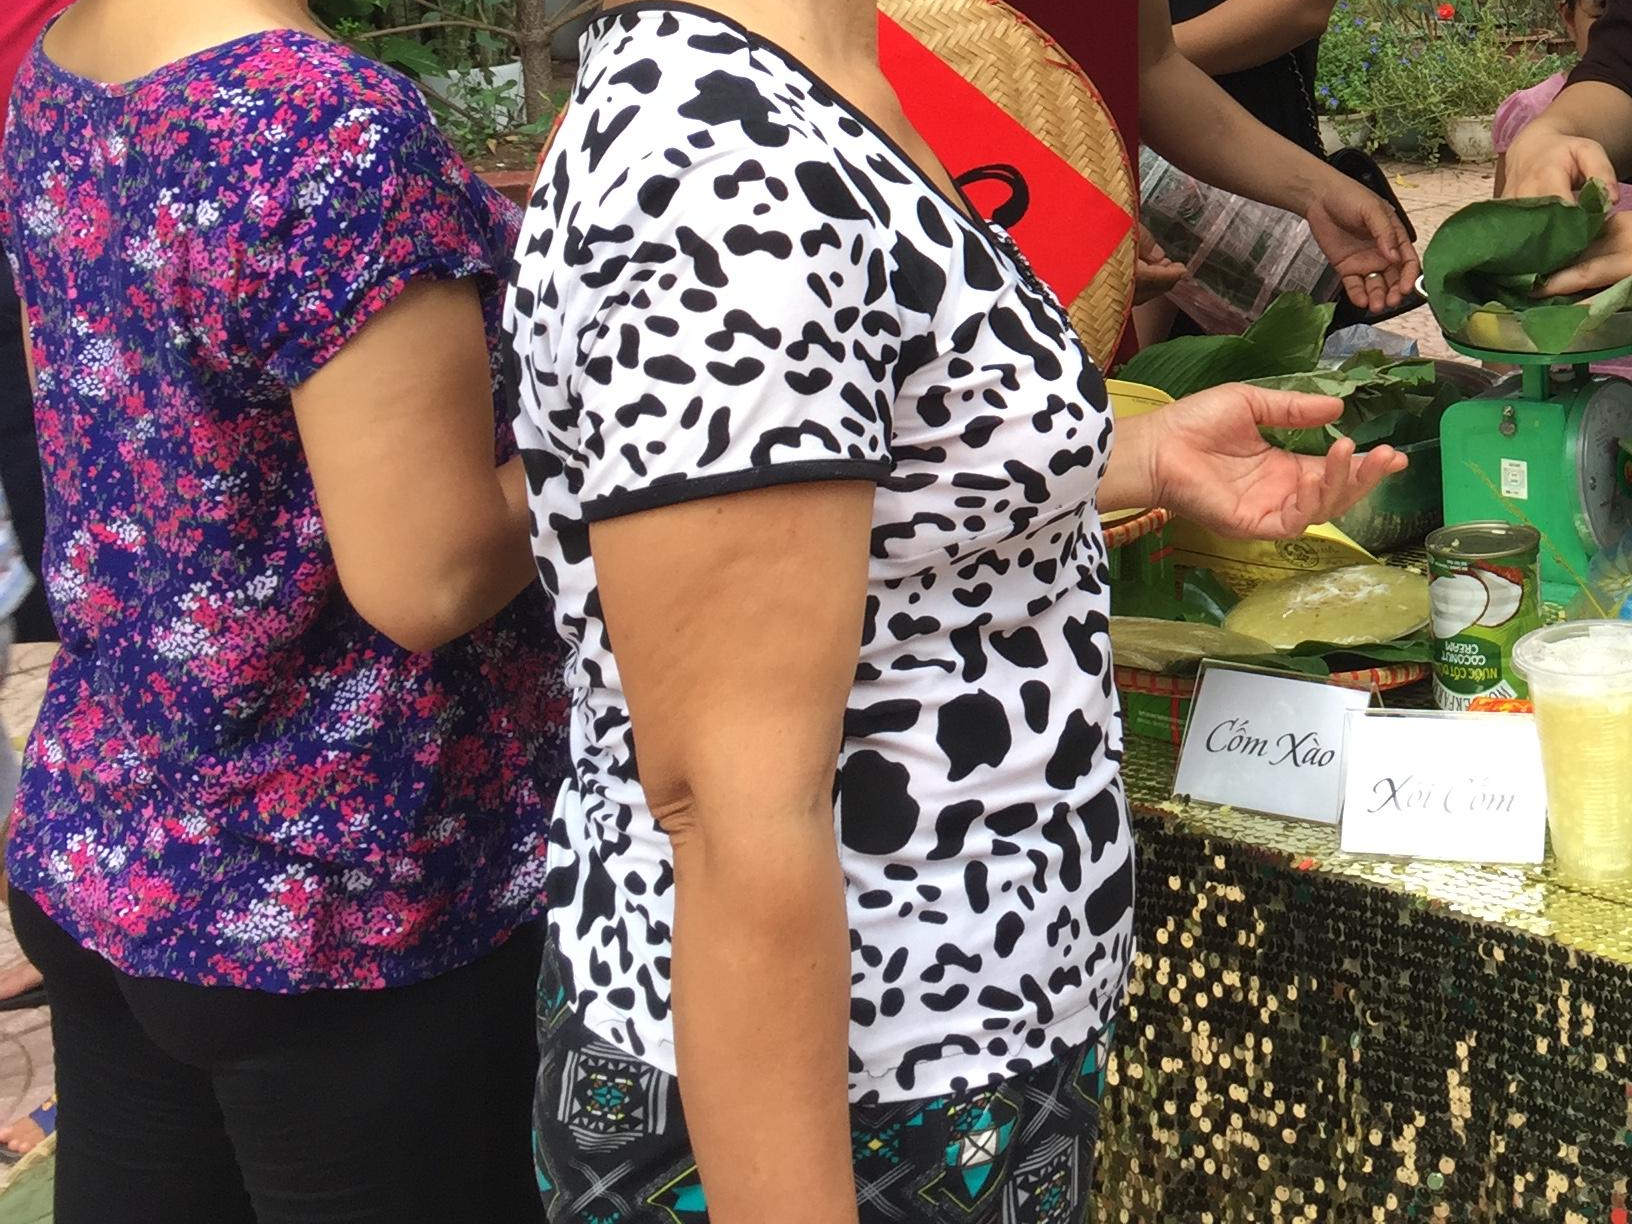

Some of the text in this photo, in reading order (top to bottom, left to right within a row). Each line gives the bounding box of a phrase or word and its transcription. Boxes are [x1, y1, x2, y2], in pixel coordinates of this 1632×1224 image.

[1444, 640, 1479, 655] CREAM
[1441, 650, 1487, 666] COCONUT
[1206, 718, 1268, 756] Cốm
[1268, 732, 1335, 767] Xào
